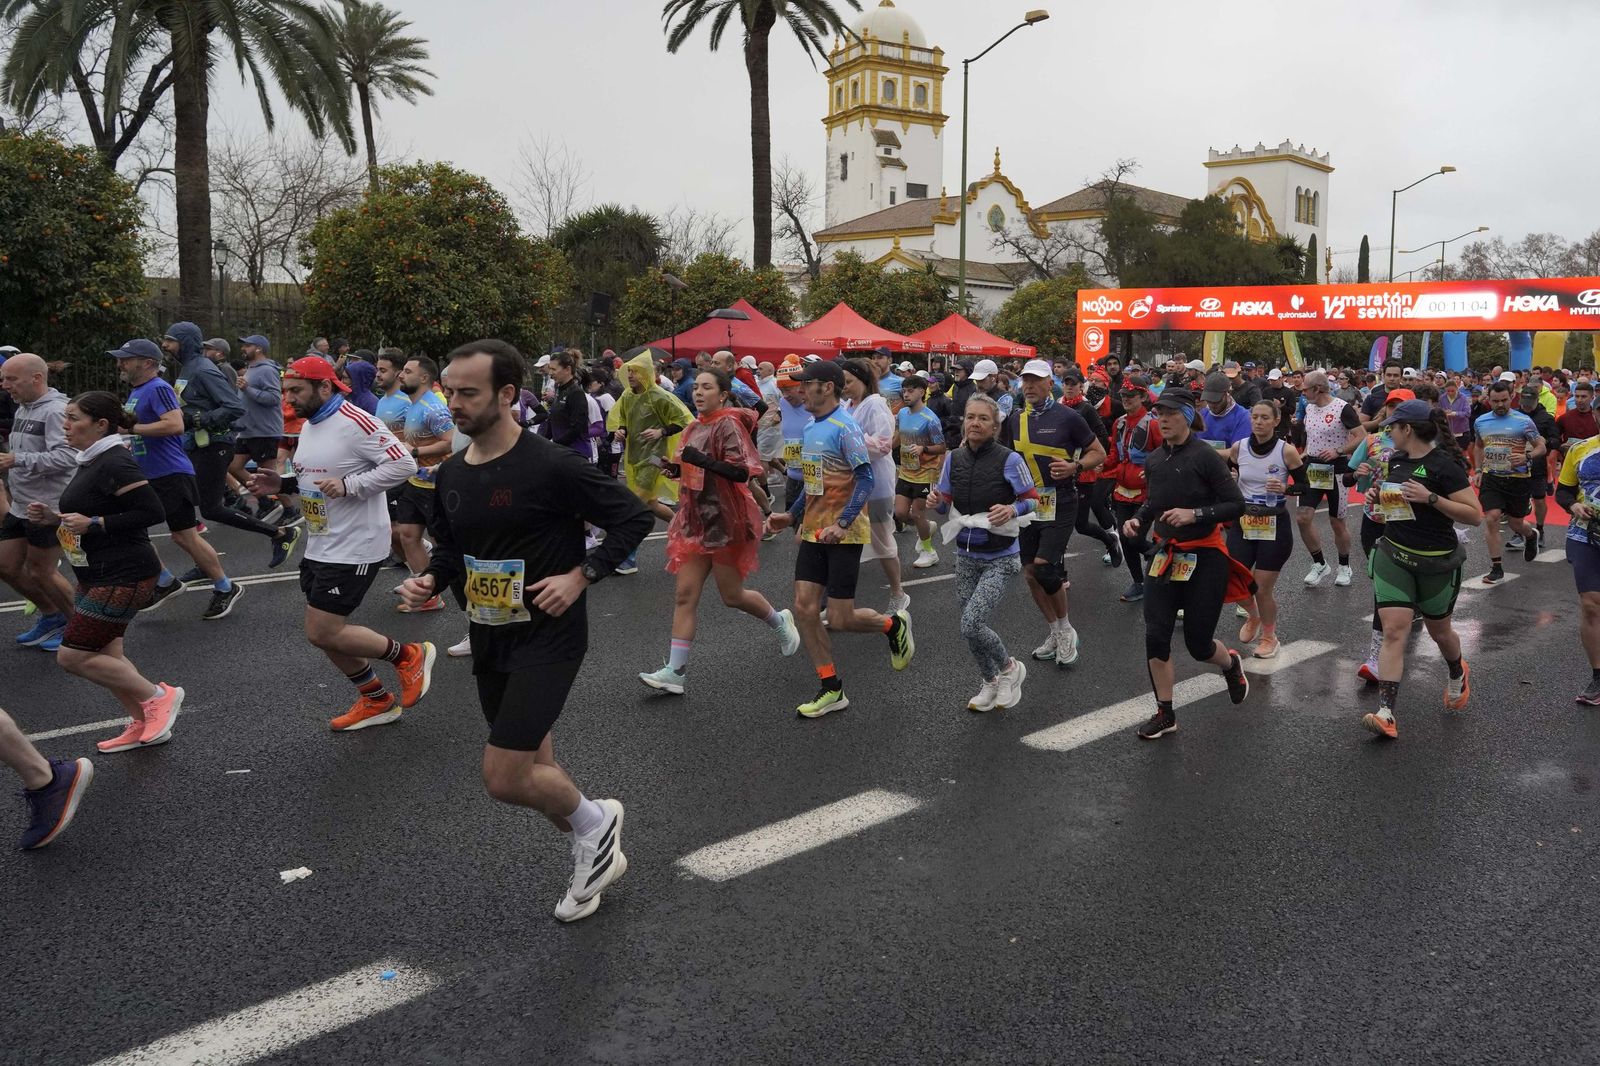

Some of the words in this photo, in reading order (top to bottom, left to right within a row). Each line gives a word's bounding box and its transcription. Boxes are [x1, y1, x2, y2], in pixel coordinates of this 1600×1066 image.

[1342, 292, 1412, 306] maratón
[1503, 295, 1560, 312] HOKA
[1156, 304, 1192, 314] Sprinter
[1232, 301, 1275, 316] HOKA
[1358, 302, 1411, 319] sevilla
[1429, 301, 1488, 313] 00:11:04
